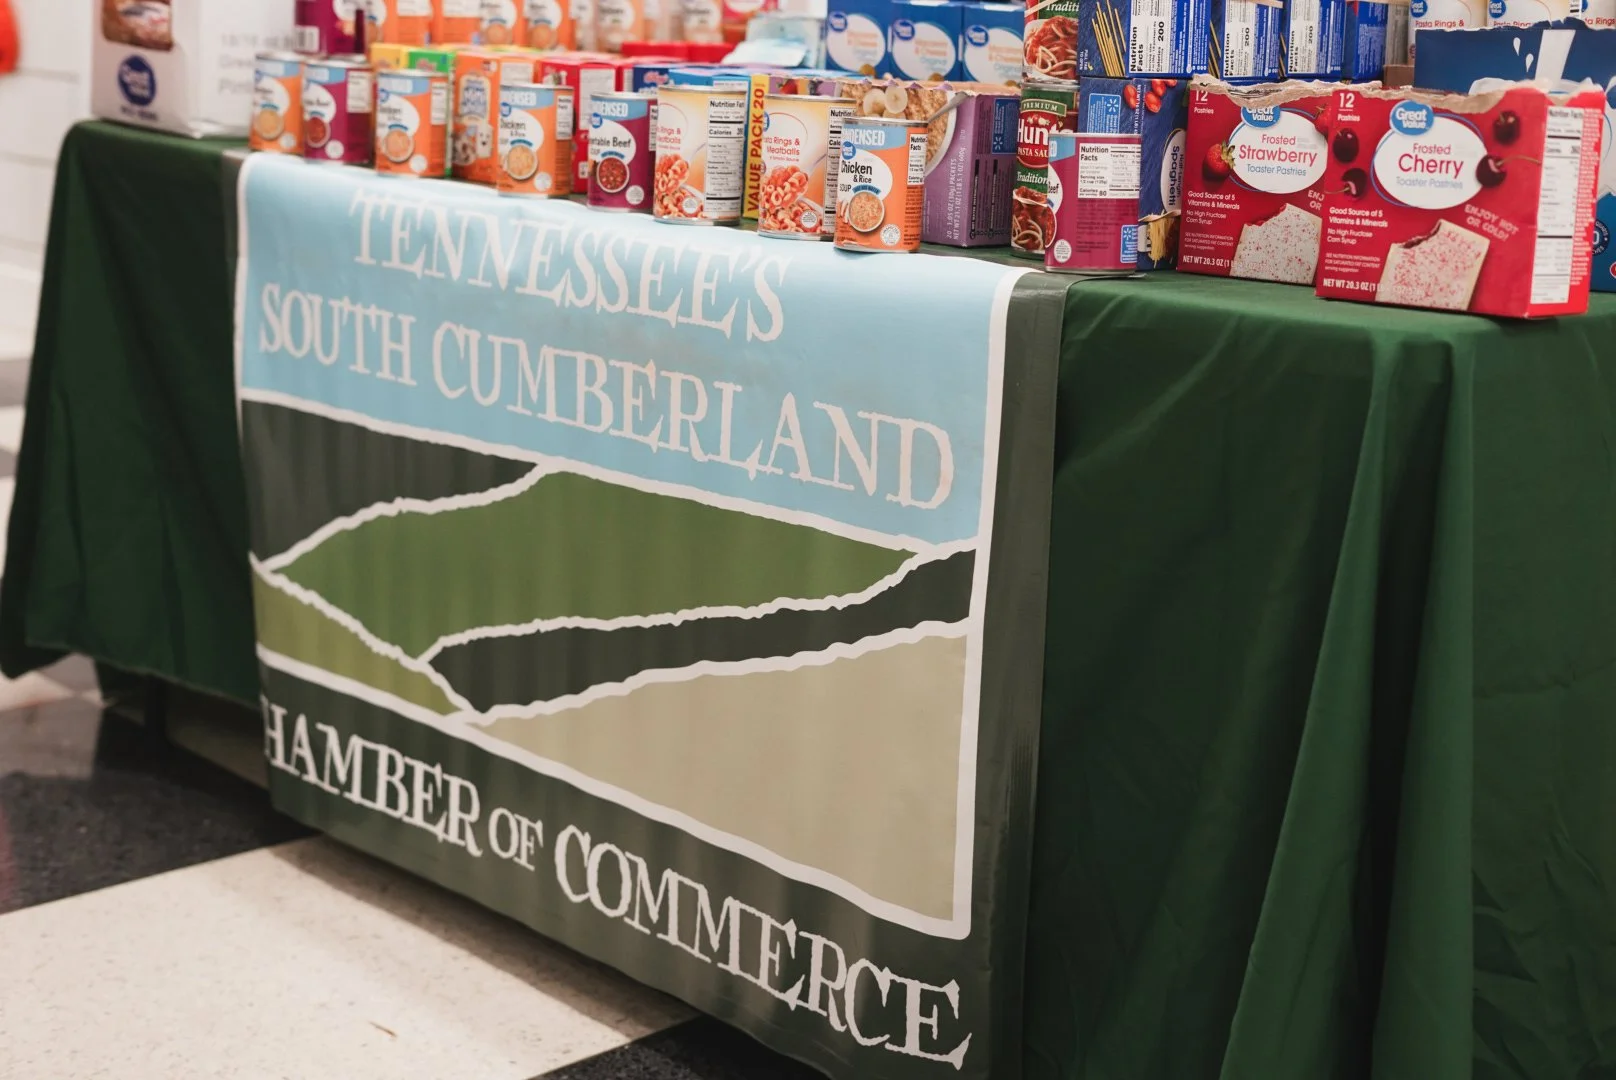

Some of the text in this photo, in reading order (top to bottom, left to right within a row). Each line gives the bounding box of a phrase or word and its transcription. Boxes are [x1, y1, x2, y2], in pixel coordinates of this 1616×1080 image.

[1046, 1, 1080, 12] Traditi
[1596, 18, 1616, 26] Rings
[1195, 90, 1208, 102] 12
[1339, 93, 1356, 108] 12
[710, 100, 736, 108] Nutrition
[1022, 101, 1059, 111] PREMIUM
[1252, 112, 1274, 122] Value
[1338, 114, 1360, 122] Pastries
[1396, 107, 1427, 121] Great
[1402, 120, 1426, 129] Value
[612, 136, 631, 148] Beef
[774, 136, 800, 146] Rings &
[1262, 134, 1296, 146] Frosted
[746, 88, 765, 212] VALUE PACK 20
[766, 146, 800, 156] Meatballs
[1080, 145, 1109, 154] Nutrition
[1412, 142, 1451, 155] Frosted
[1080, 153, 1098, 162] Facts
[1238, 144, 1318, 168] Strawberry
[841, 160, 872, 175] Chicken
[1247, 164, 1306, 176] Toaster Pastries
[1398, 153, 1464, 180] Cherry
[853, 175, 872, 184] & Rice
[1017, 171, 1049, 184] Tradition
[1168, 146, 1180, 206] Spaghetti
[1396, 176, 1464, 190] Toaster Pastries
[1188, 190, 1204, 199] Good
[1204, 192, 1224, 200] Source
[1308, 189, 1325, 202] ENJ
[1188, 199, 1210, 208] Vitamins
[1216, 202, 1240, 210] Minerals
[1310, 200, 1322, 210] OR
[1194, 210, 1206, 218] High
[1206, 212, 1226, 220] Fructose
[1329, 206, 1348, 214] Good
[1348, 208, 1370, 216] Source
[1199, 218, 1212, 226] Syrup
[1329, 216, 1355, 225] Vitamins
[1361, 218, 1388, 228] Minerals
[1464, 204, 1520, 235] ENJOY HOT
[1349, 230, 1372, 238] Fructose
[1466, 216, 1511, 242] OR COLD!
[1341, 236, 1357, 245] Syrup
[349, 186, 792, 342] TENNESSEE'S
[1183, 255, 1230, 268] NET WT 20.3 OZ (1
[1323, 278, 1334, 287] NET
[1335, 279, 1346, 288] WT
[1346, 280, 1360, 289] 20.3
[1360, 281, 1369, 290] OZ
[1369, 282, 1376, 292] (1
[259, 283, 955, 510] SOUTH CUMBERLAND
[261, 695, 972, 1071] HAMBER OF COMMERCE
